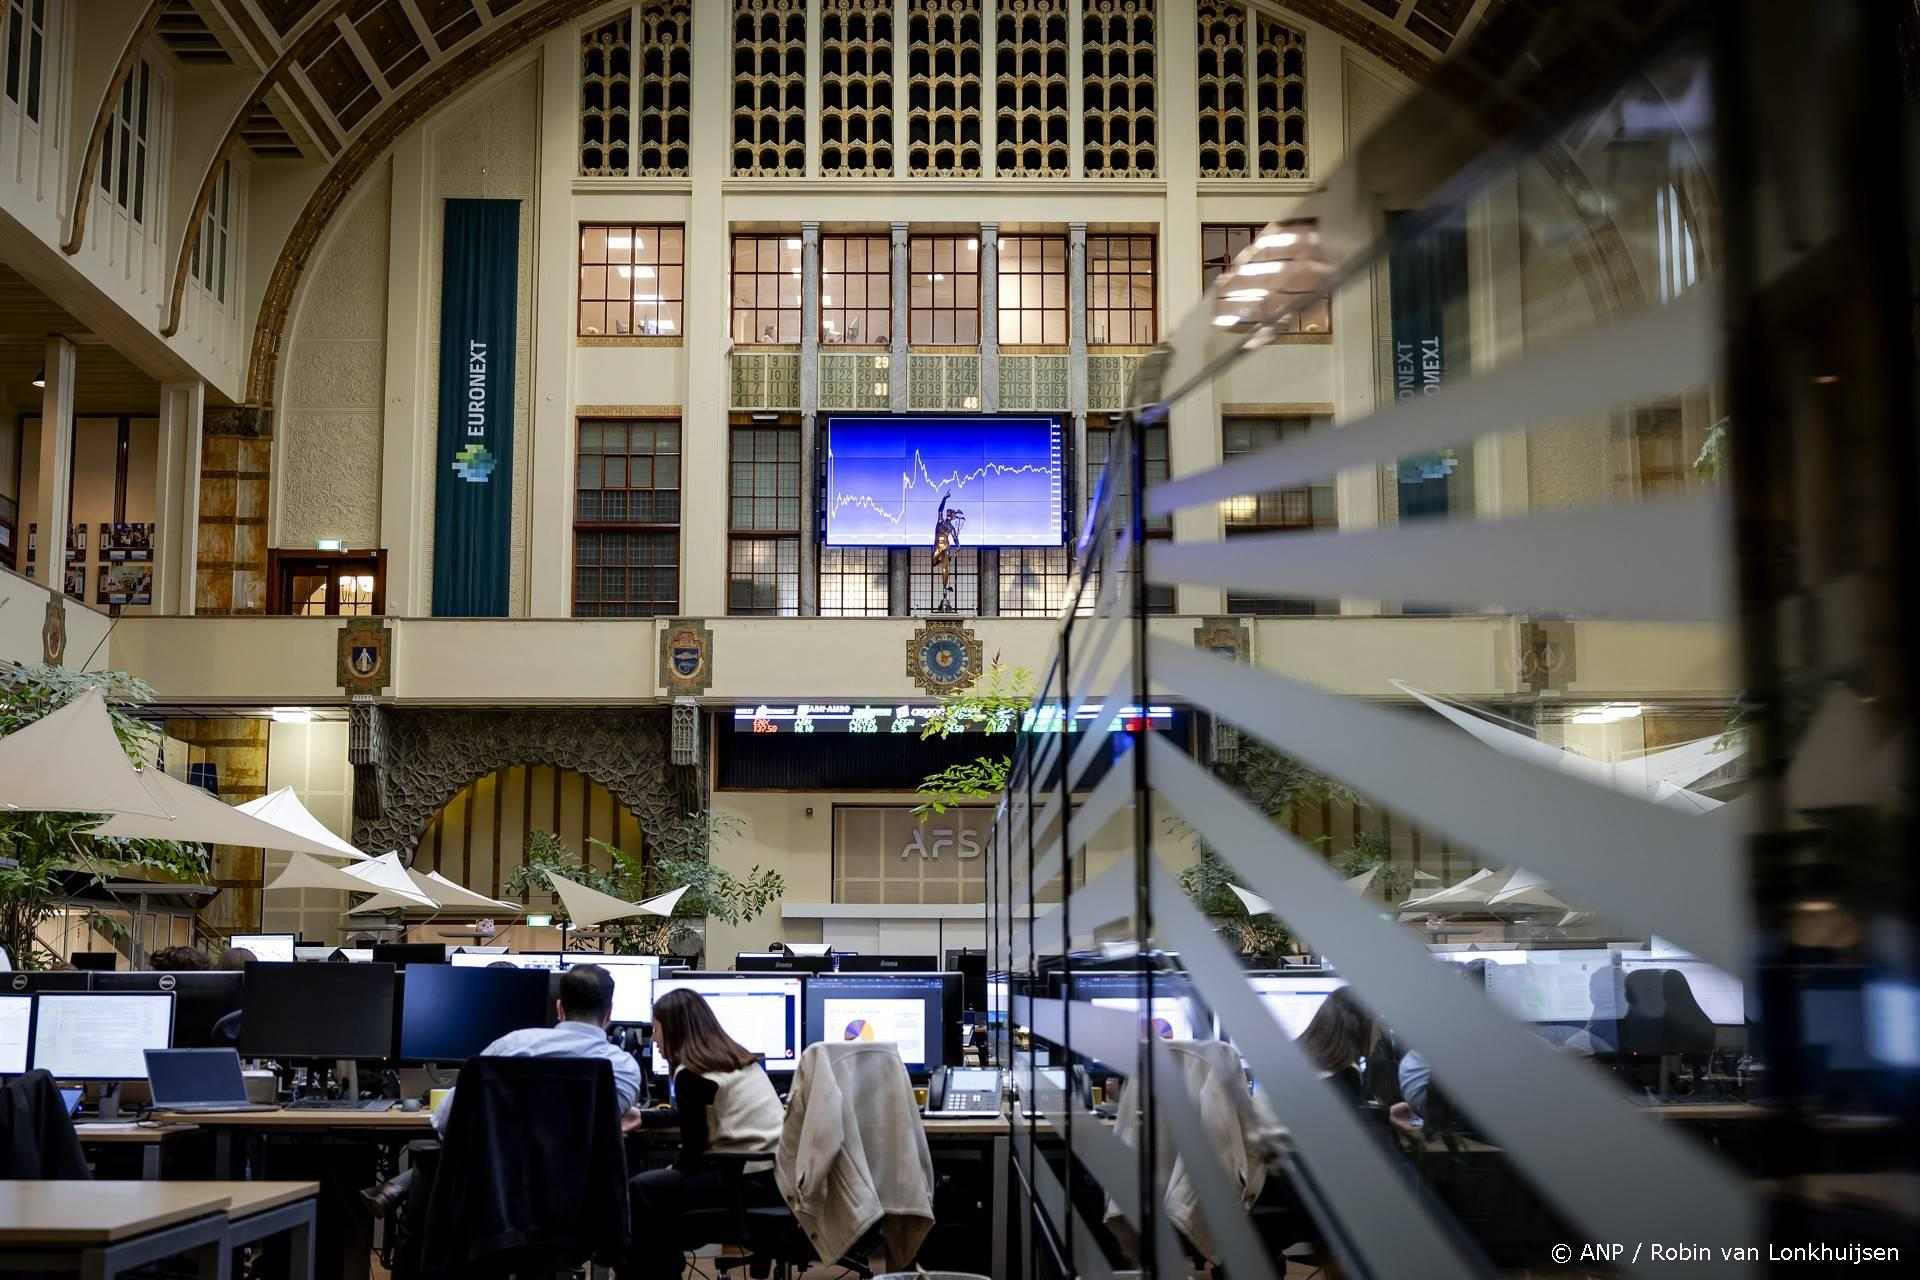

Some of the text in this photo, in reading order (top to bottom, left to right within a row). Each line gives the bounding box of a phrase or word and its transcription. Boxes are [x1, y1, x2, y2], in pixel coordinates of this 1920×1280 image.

[754, 356, 760, 367] 5
[773, 356, 778, 366] 9
[788, 356, 799, 367] 13
[822, 356, 833, 368] 17
[859, 356, 871, 368] 25
[875, 357, 889, 368] 29
[911, 356, 977, 368] 33 37 41 45
[1055, 357, 1067, 368] 61
[1089, 358, 1101, 369] 65
[1106, 358, 1119, 369] 69
[737, 369, 799, 381] 2 6 10 14
[822, 370, 833, 380] 18
[859, 370, 871, 380] 26
[875, 370, 888, 380] 30
[911, 370, 977, 381] 34 38 42 46
[1055, 370, 1067, 381] 62
[1106, 371, 1119, 381] 70
[1397, 341, 1415, 400] ONEXT
[468, 340, 487, 437] EURONEXT
[737, 383, 799, 394] 3 7 11 15
[822, 383, 888, 395] 19 23 27 31
[911, 383, 977, 394] 35 39 43 47
[1000, 384, 1011, 395] 51
[1037, 384, 1049, 395] 59
[1055, 384, 1067, 395] 63
[1089, 384, 1101, 395] 67
[1106, 384, 1117, 395] 71
[736, 396, 799, 407] 4 8 12 16
[929, 397, 941, 408] 40
[948, 397, 960, 408] 44
[965, 397, 977, 408] 48
[1000, 397, 1067, 408] 52 56 60 64
[1089, 398, 1119, 409] 68 72
[901, 829, 980, 858] AFS
